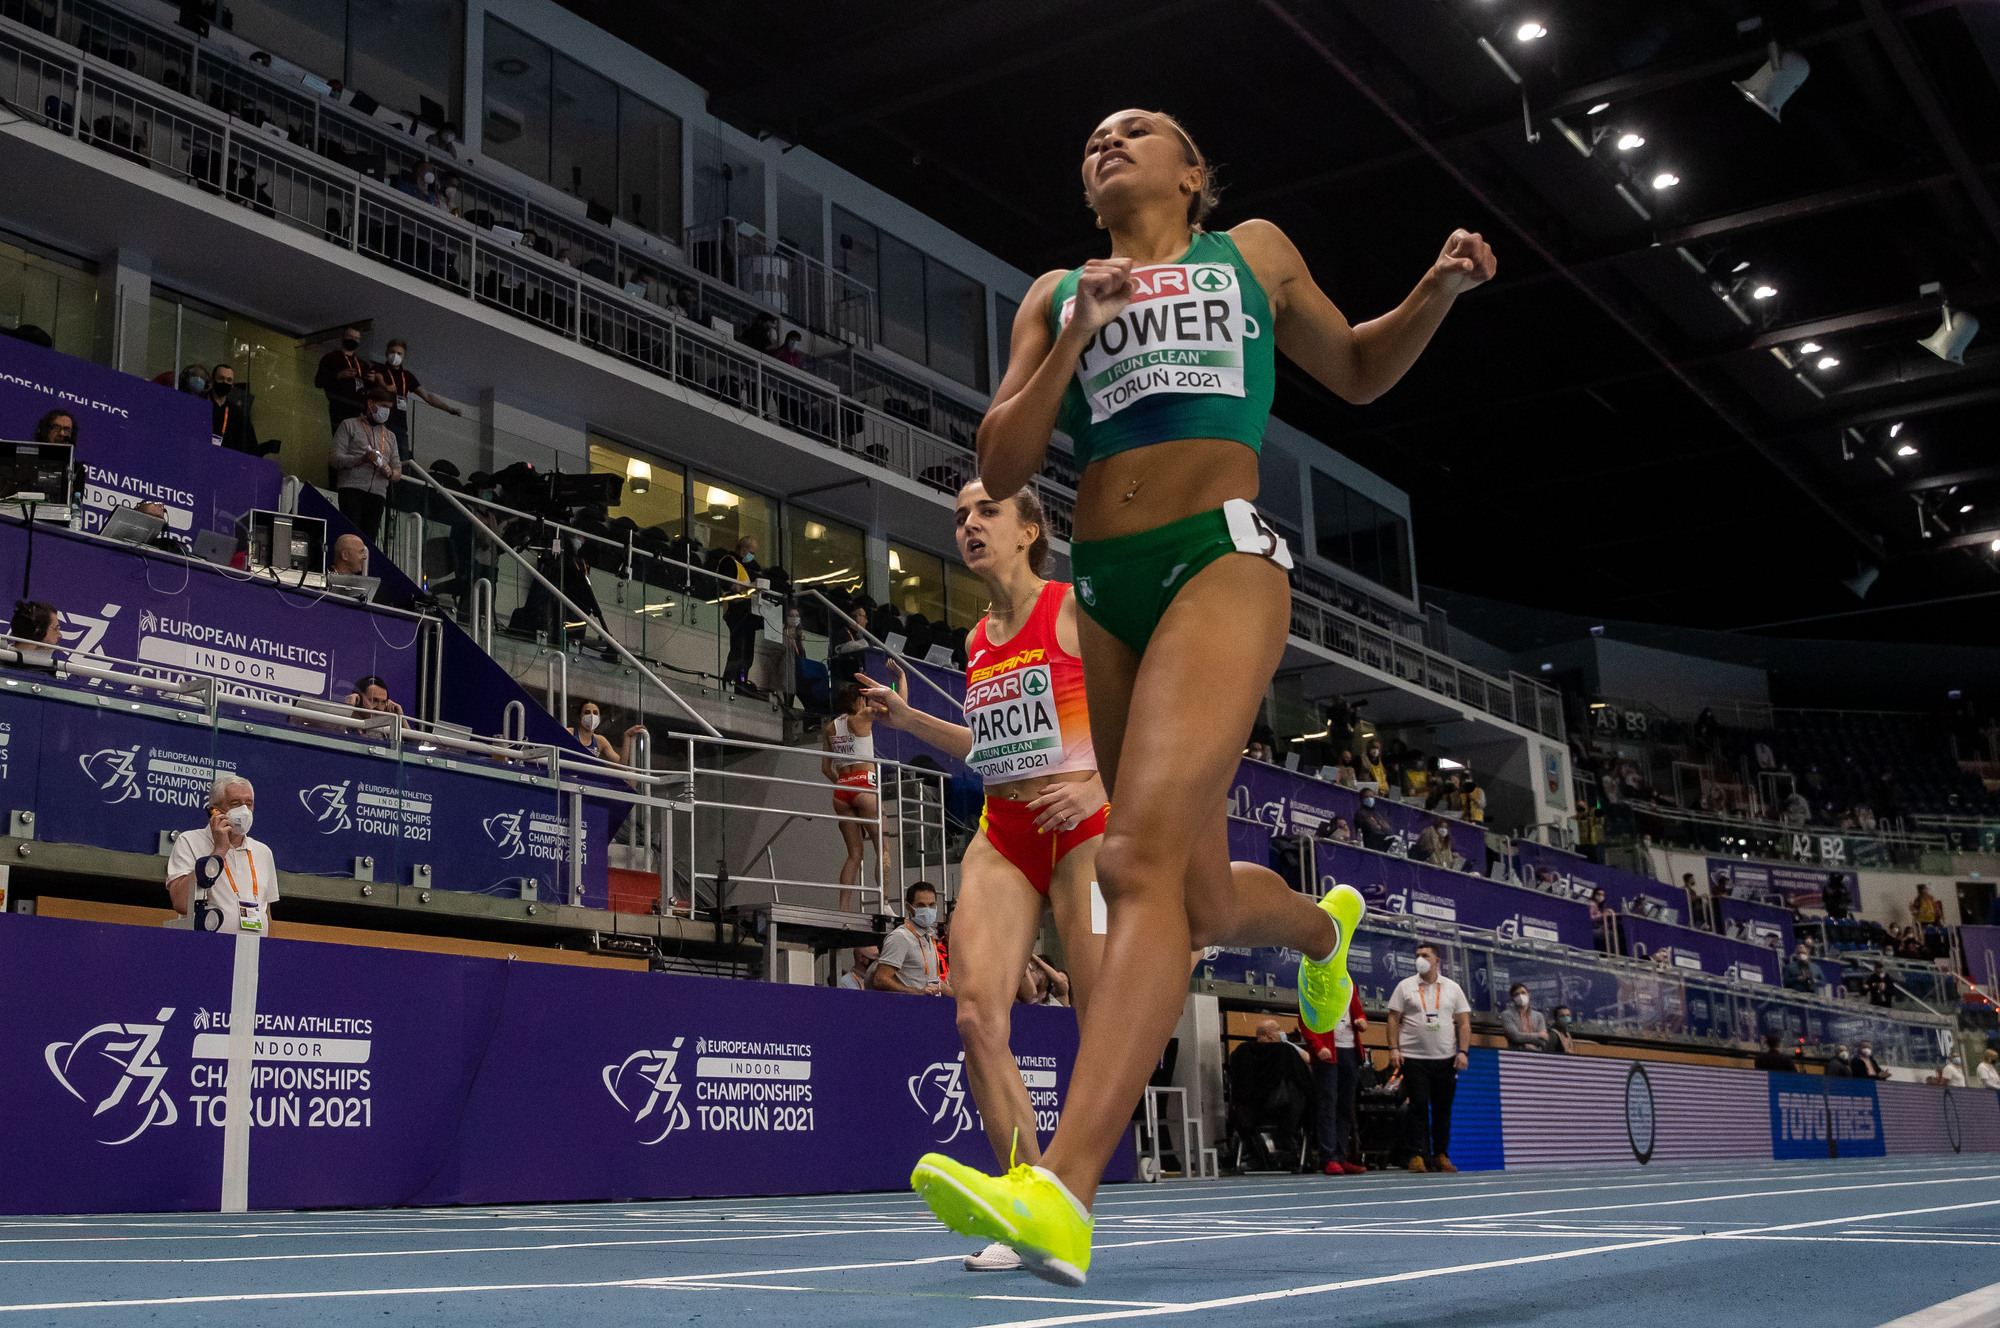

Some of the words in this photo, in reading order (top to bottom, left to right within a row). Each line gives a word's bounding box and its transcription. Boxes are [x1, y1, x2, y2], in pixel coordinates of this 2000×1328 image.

[1134, 270, 1186, 296] AR
[1078, 299, 1233, 371] POWER
[1107, 371, 1113, 382] I
[1115, 360, 1145, 377] RUN
[1102, 368, 1170, 409] TORUŃ
[1176, 371, 1222, 388] 2021
[83, 464, 118, 487] PEAN
[121, 475, 195, 507] ATHLETICS
[1250, 512, 1277, 557] 5
[160, 617, 247, 650] EUROPEAN
[250, 637, 328, 668] ATHLETICS
[194, 651, 276, 681] INDOOR
[970, 648, 1046, 684] ESPAÑA
[965, 676, 1020, 711] SPAR
[158, 750, 198, 764] EUROPEAN
[983, 748, 1000, 759] RUN
[1017, 753, 1049, 770] 2021
[173, 765, 212, 777] INDOOR
[837, 774, 867, 783] OLSKA
[147, 773, 211, 793] CHAMPIONS
[365, 784, 399, 796] EUROPEAN
[401, 790, 433, 801] ATHLETICS
[146, 786, 200, 809] TORUŃ
[356, 805, 431, 826] CHAMPIONSHIPS
[403, 825, 431, 842] 2021
[1792, 834, 1812, 857] A2
[1820, 837, 1845, 860] B2
[213, 1012, 295, 1031] EUPEAN
[298, 1017, 373, 1035] ATHLETICS
[254, 1041, 322, 1057] NDOOR
[708, 1040, 761, 1055] EUROPEAN
[763, 1043, 812, 1057] ATHLETICS
[730, 1063, 780, 1075] INDOOR
[1022, 1056, 1057, 1068] ATHLETICS
[696, 1081, 813, 1102] CHAMPIONSHIPS
[308, 1097, 371, 1127] 2021
[696, 1102, 769, 1131] TORUŃ
[773, 1106, 814, 1131] 2021
[1777, 1091, 1828, 1141] TOYO
